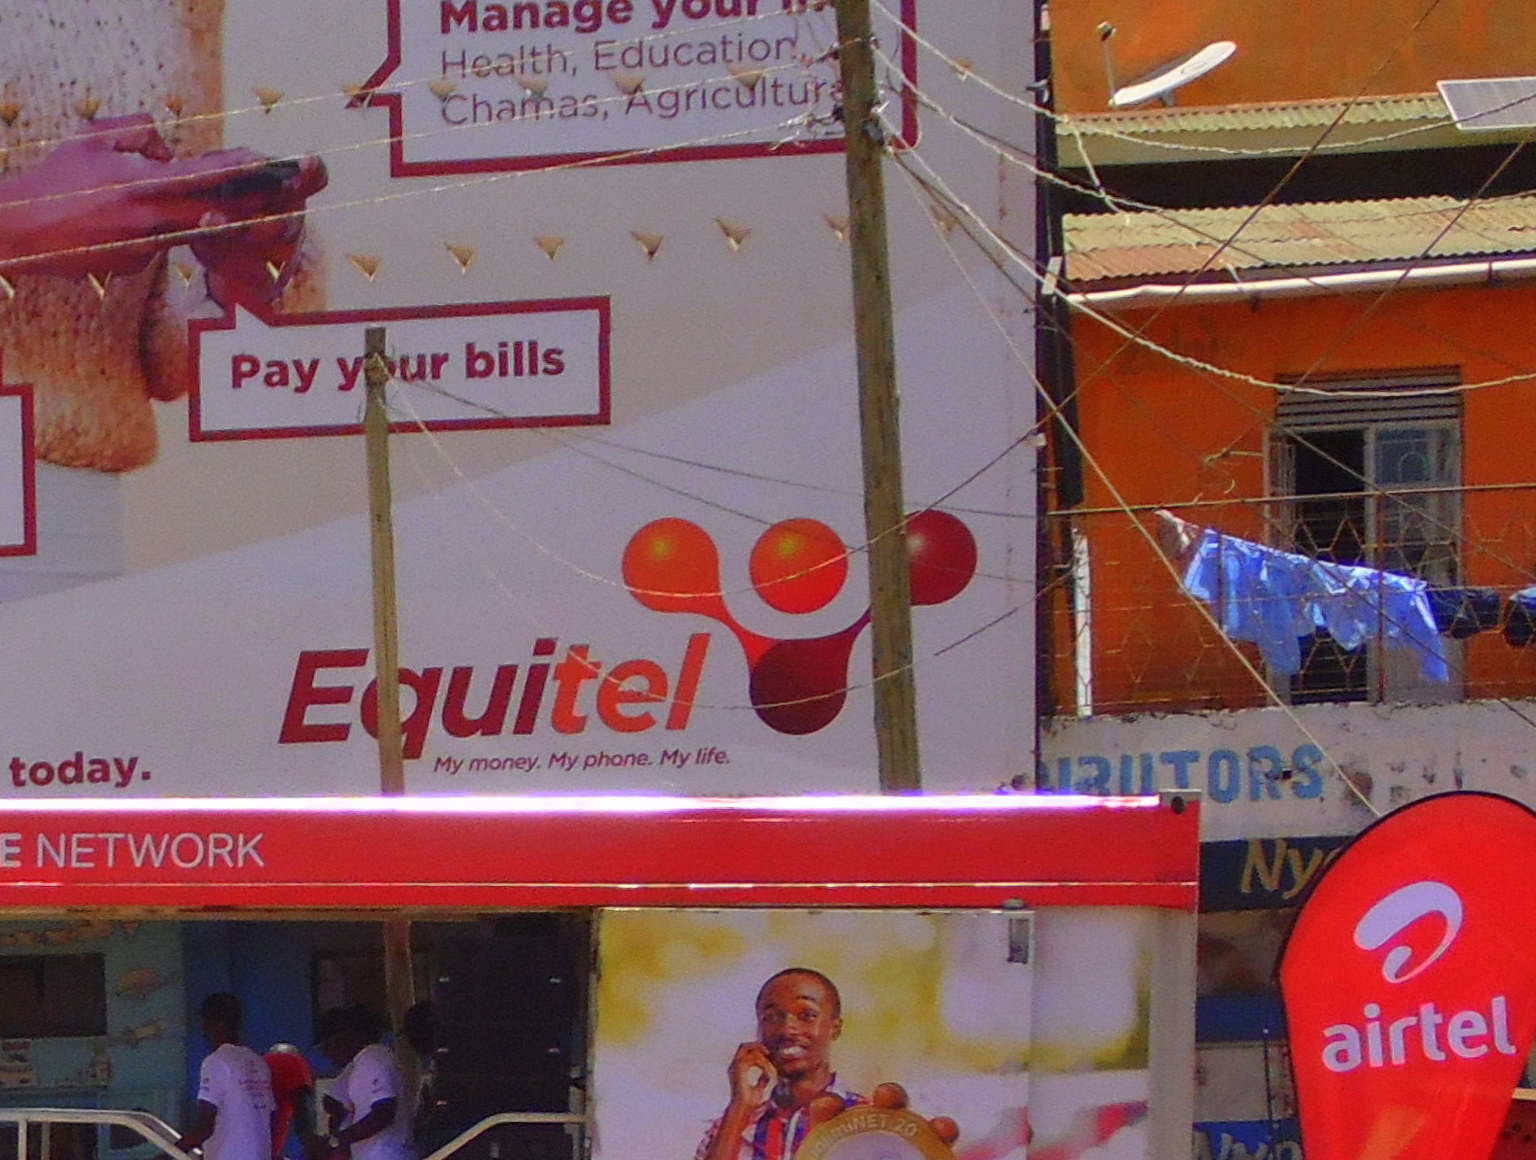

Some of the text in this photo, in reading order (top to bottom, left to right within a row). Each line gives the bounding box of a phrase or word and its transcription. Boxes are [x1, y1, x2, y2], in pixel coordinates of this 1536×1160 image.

[440, 0, 634, 34] Manage
[651, 0, 759, 29] your
[441, 44, 577, 78] Health,
[441, 92, 609, 126] Chamas,
[231, 340, 567, 394] Pay yur bills
[278, 632, 711, 761] Equitel
[9, 750, 152, 790] today.
[434, 745, 731, 776] My money. My phone. My life.
[36, 829, 266, 871] NETWORK
[1240, 838, 1338, 900] Ny
[1321, 995, 1516, 1073] airtel
[894, 1117, 917, 1137] 20
